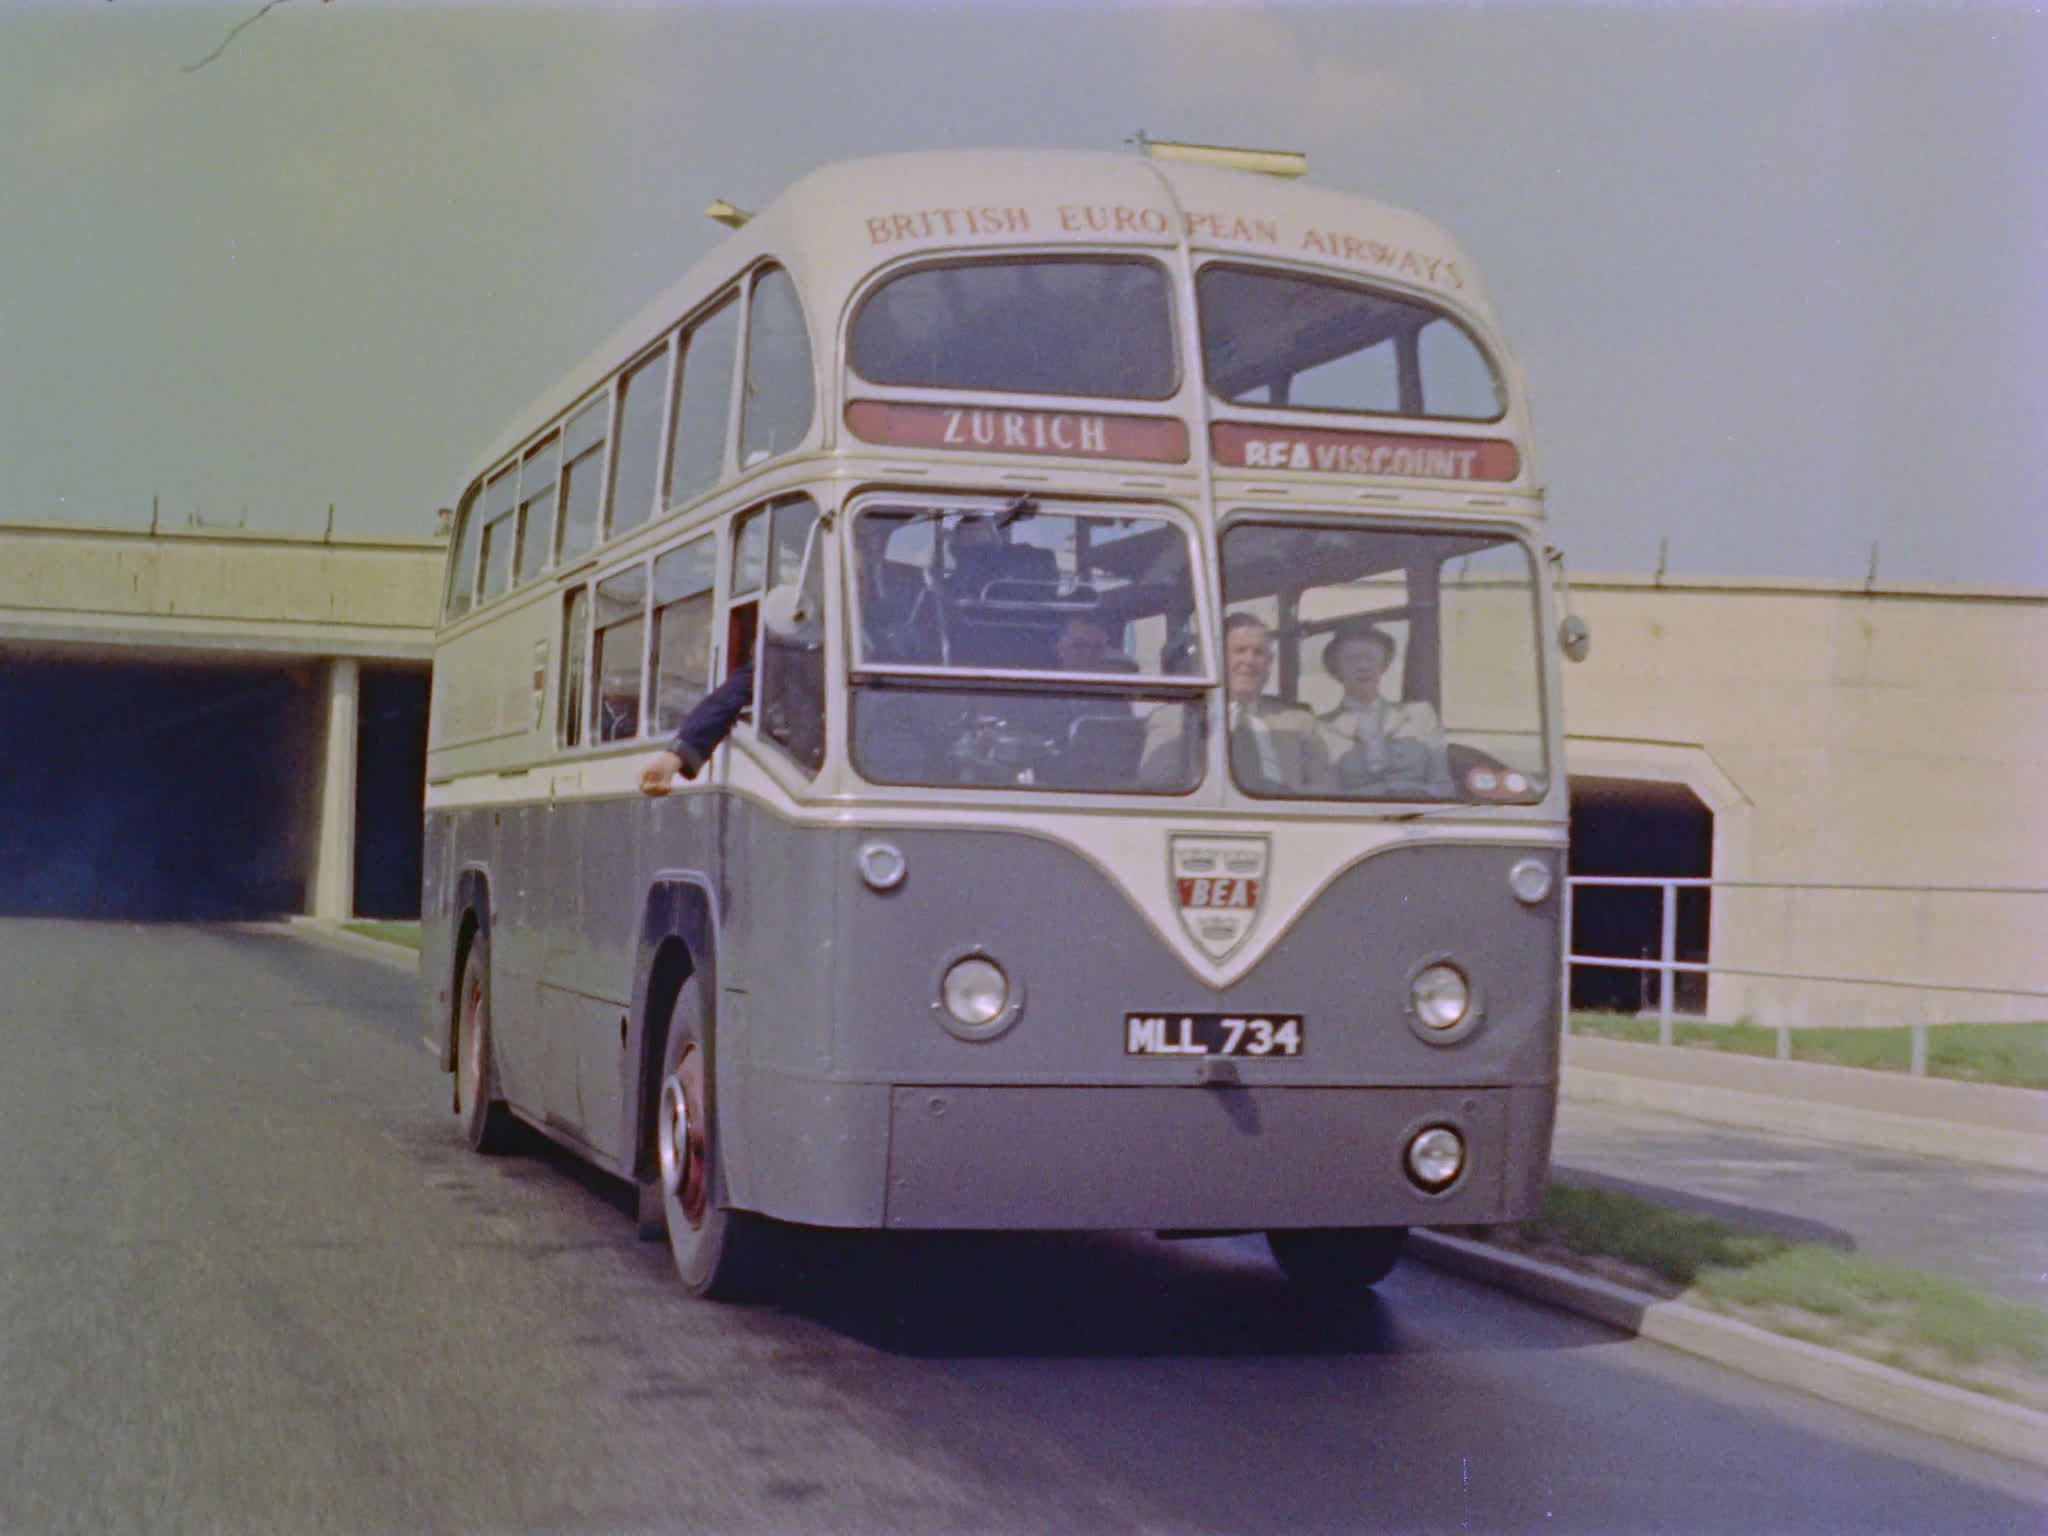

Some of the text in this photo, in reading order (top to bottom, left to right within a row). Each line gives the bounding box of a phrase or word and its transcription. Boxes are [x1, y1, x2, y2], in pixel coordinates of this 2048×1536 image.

[864, 205, 1464, 290] BRITISH EUROPEAN AIRWAYS
[944, 411, 1107, 452] ZURICH
[1191, 879, 1248, 907] BEA
[1128, 1018, 1300, 1055] MLL 734
